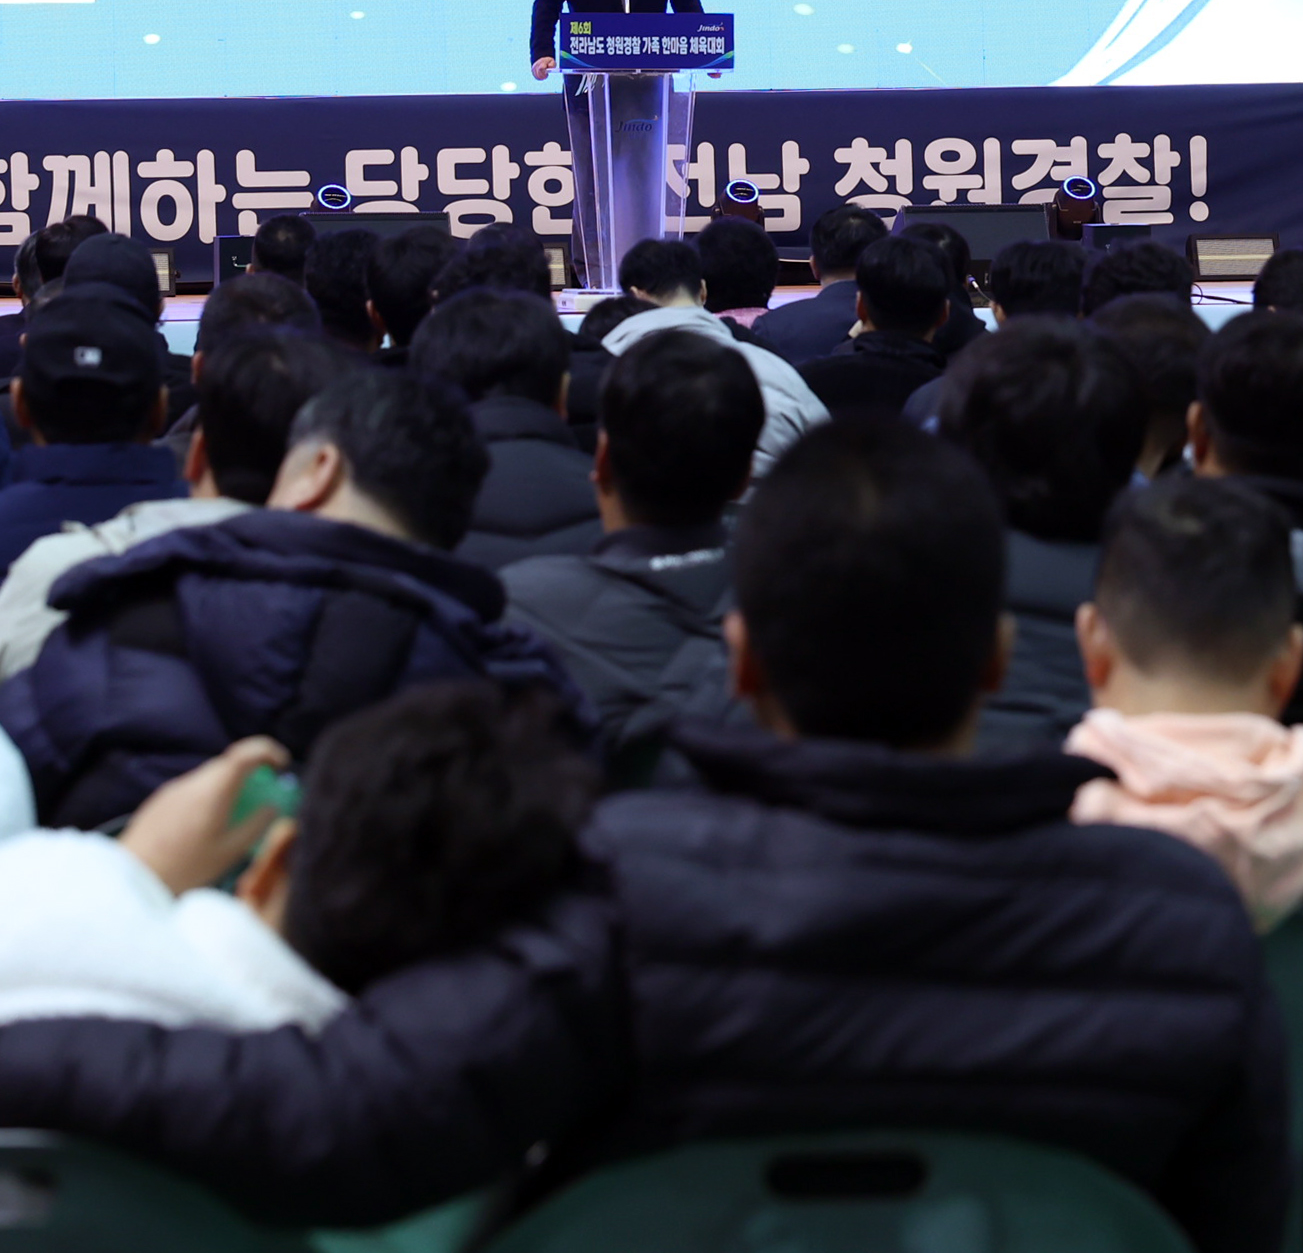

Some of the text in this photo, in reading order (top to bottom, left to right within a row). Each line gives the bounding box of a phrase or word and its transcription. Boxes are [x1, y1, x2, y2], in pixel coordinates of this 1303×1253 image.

[569, 21, 592, 35] 제6회
[697, 24, 720, 33] Jindo
[569, 36, 725, 55] 전라남도 청원경찰 가족 한마음 체육대회
[615, 120, 653, 133] Jindo
[344, 141, 573, 239] 당당한
[833, 132, 1210, 229] 청원경찰!
